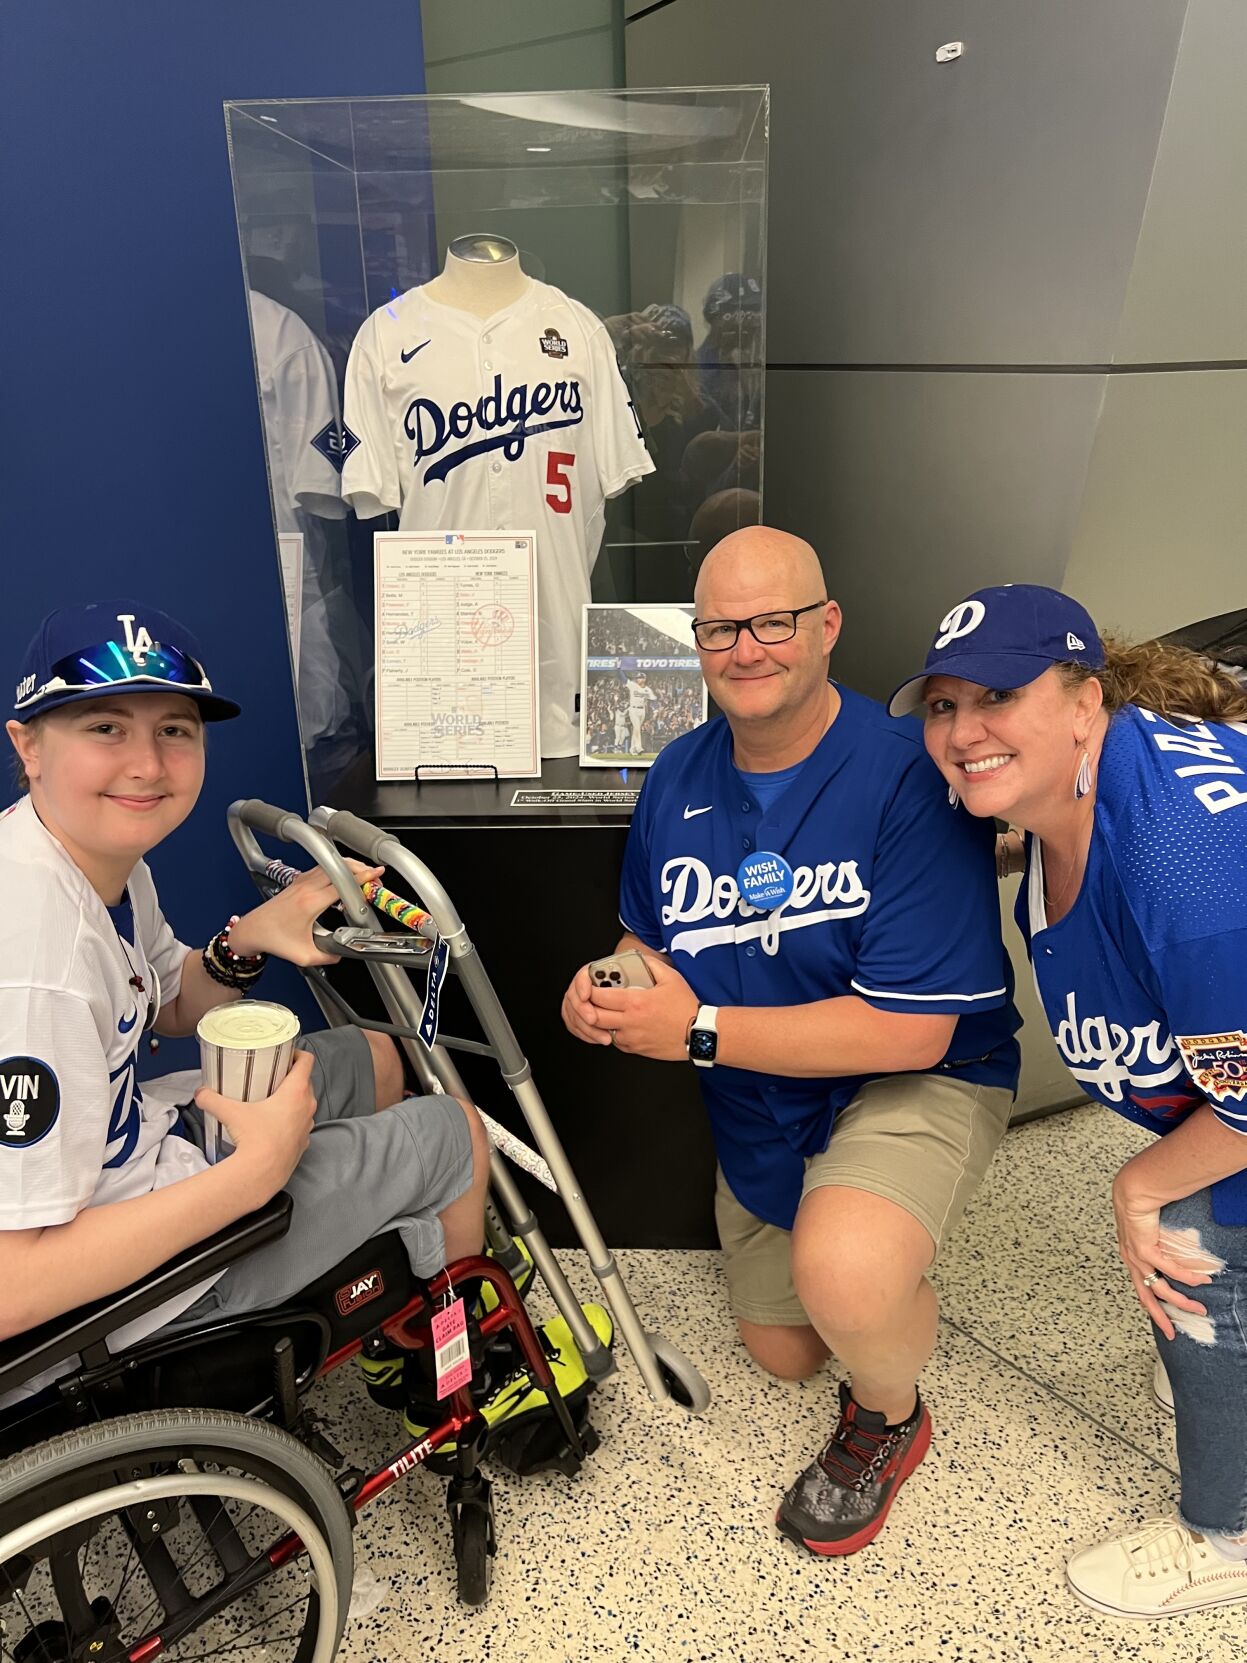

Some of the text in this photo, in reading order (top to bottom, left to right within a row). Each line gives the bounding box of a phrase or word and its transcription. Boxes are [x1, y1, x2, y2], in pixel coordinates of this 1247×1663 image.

[404, 374, 584, 487] Dodgers
[546, 451, 576, 513] 5
[116, 614, 154, 668] LA
[636, 659, 668, 668] TOYO
[668, 659, 701, 668] TIRES
[431, 713, 482, 726] WORLD
[433, 725, 485, 737] SERIES
[744, 859, 778, 877] WISH
[743, 869, 785, 889] FAMILY
[428, 971, 438, 1021] DELTA
[1212, 1060, 1244, 1081] 50
[0, 1074, 40, 1100] VIN
[350, 1275, 377, 1299] JAY
[435, 1328, 453, 1344] CLAIM
[442, 1320, 456, 1333] GATE
